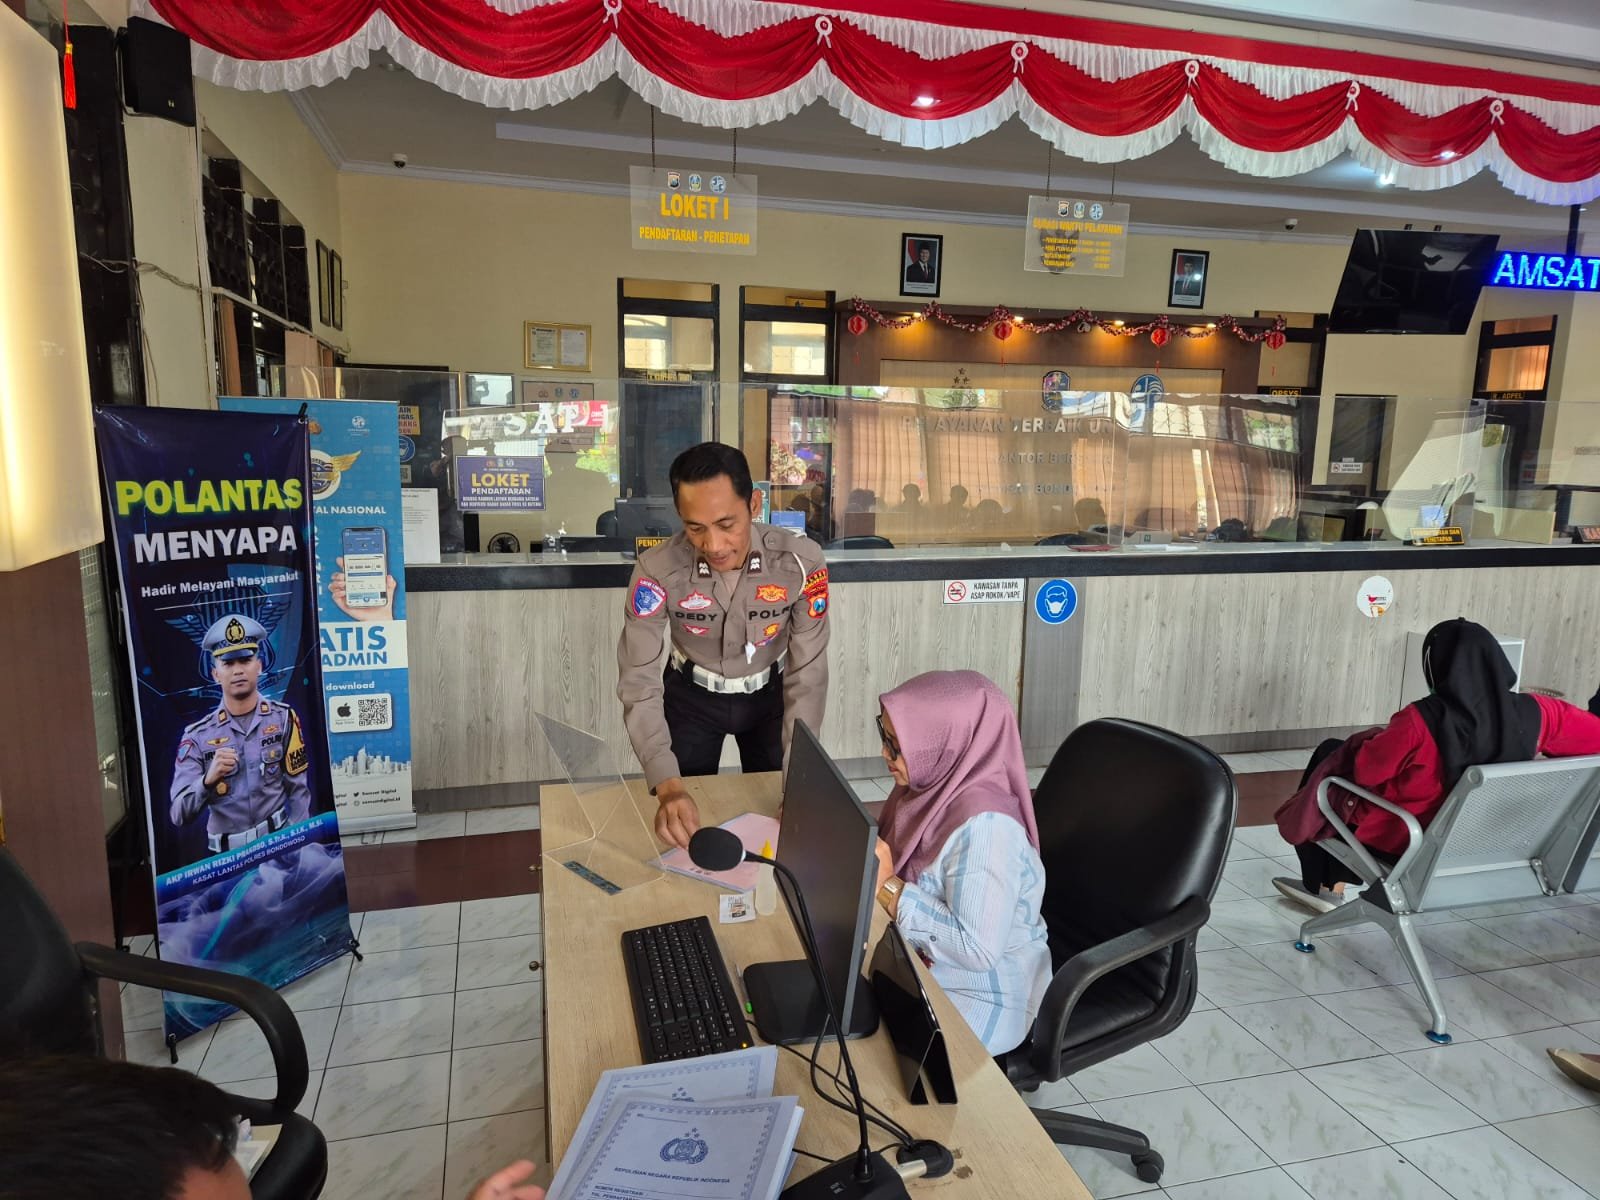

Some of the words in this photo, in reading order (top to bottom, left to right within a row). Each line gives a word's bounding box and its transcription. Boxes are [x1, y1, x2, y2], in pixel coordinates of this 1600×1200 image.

[660, 192, 719, 220] LOKET
[723, 196, 730, 221] I
[639, 225, 698, 243] PENDAFTARAN
[703, 230, 750, 246] PENETAPAN
[471, 472, 530, 488] LOKET
[115, 478, 303, 516] POLANTAS
[471, 487, 531, 495] PENDAFTARAN
[330, 505, 387, 515] NASIONAL
[133, 525, 297, 564] MENYAPA
[141, 583, 177, 598] Hadir
[179, 577, 235, 595] Melayani
[236, 571, 299, 588] Masyarakat
[973, 582, 1001, 590] KAWASAN
[1001, 581, 1019, 589] TANPA
[970, 592, 985, 600] ASAP
[675, 611, 718, 622] DEDY
[321, 652, 388, 667] ADMIN
[325, 681, 376, 691] download
[192, 872, 216, 885] KASAT
[217, 861, 244, 879] LANTAS
[244, 851, 266, 866] POLRES
[266, 836, 306, 857] BONDOWOSO
[165, 872, 185, 886] AKP
[184, 863, 212, 879] IRWAN
[212, 855, 236, 871] RIZKI
